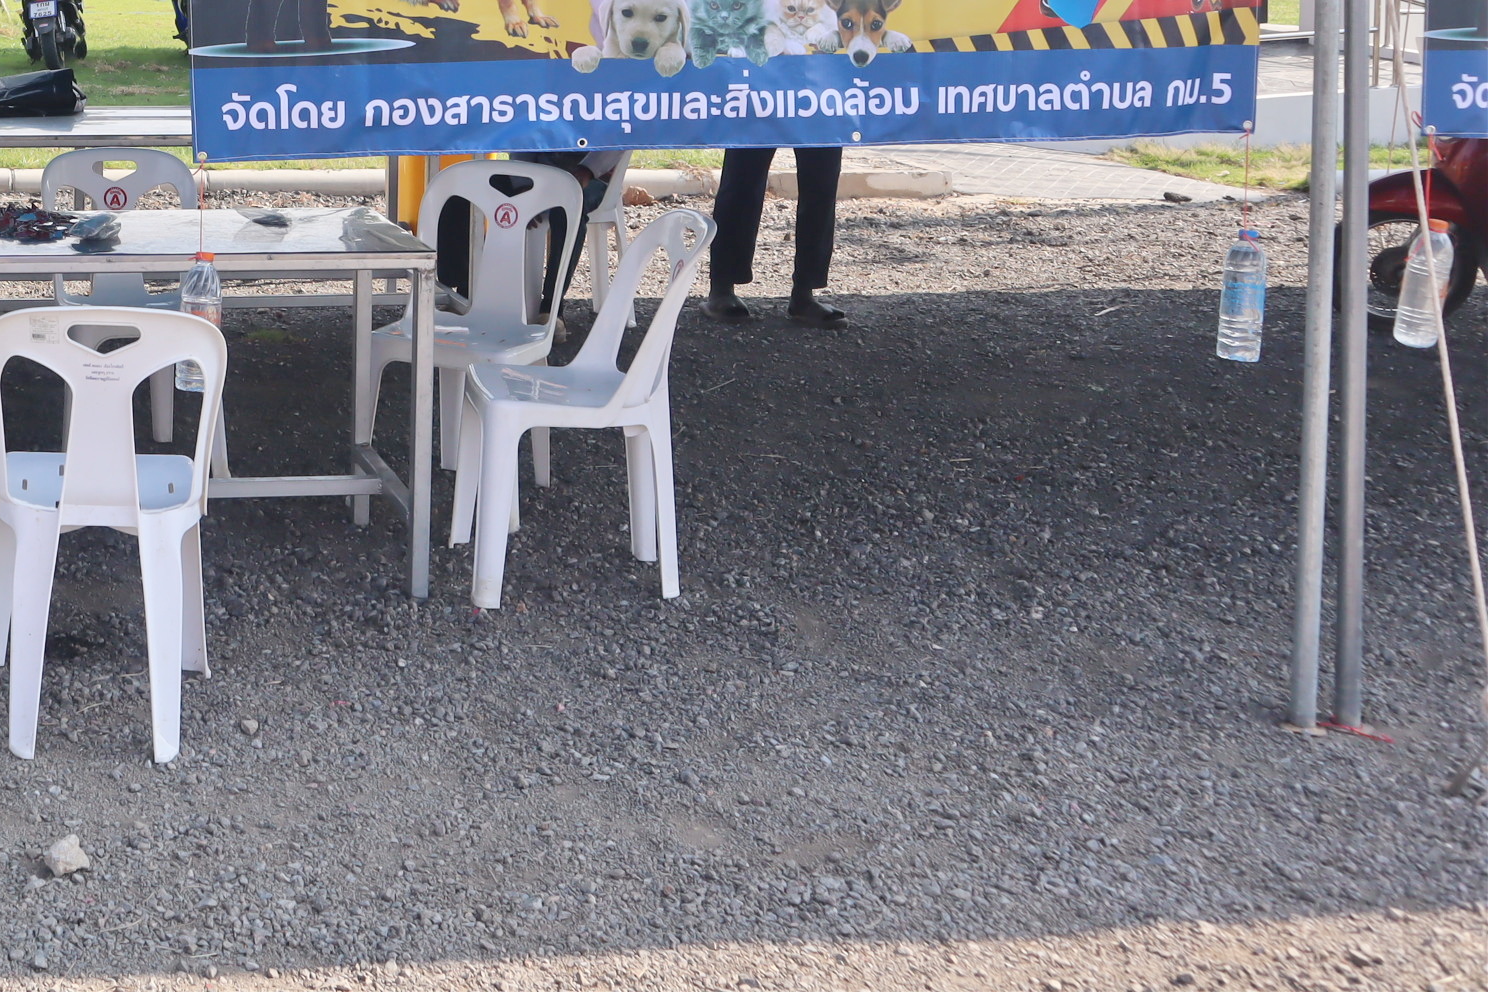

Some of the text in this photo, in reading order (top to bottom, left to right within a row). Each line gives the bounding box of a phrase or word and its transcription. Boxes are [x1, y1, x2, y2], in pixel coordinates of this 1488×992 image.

[221, 83, 346, 131] จัดโดย
[364, 69, 920, 134] กองสาธารณสุขและสิ่งแวดล้อม
[937, 70, 1152, 114] เทศบาลตำบล
